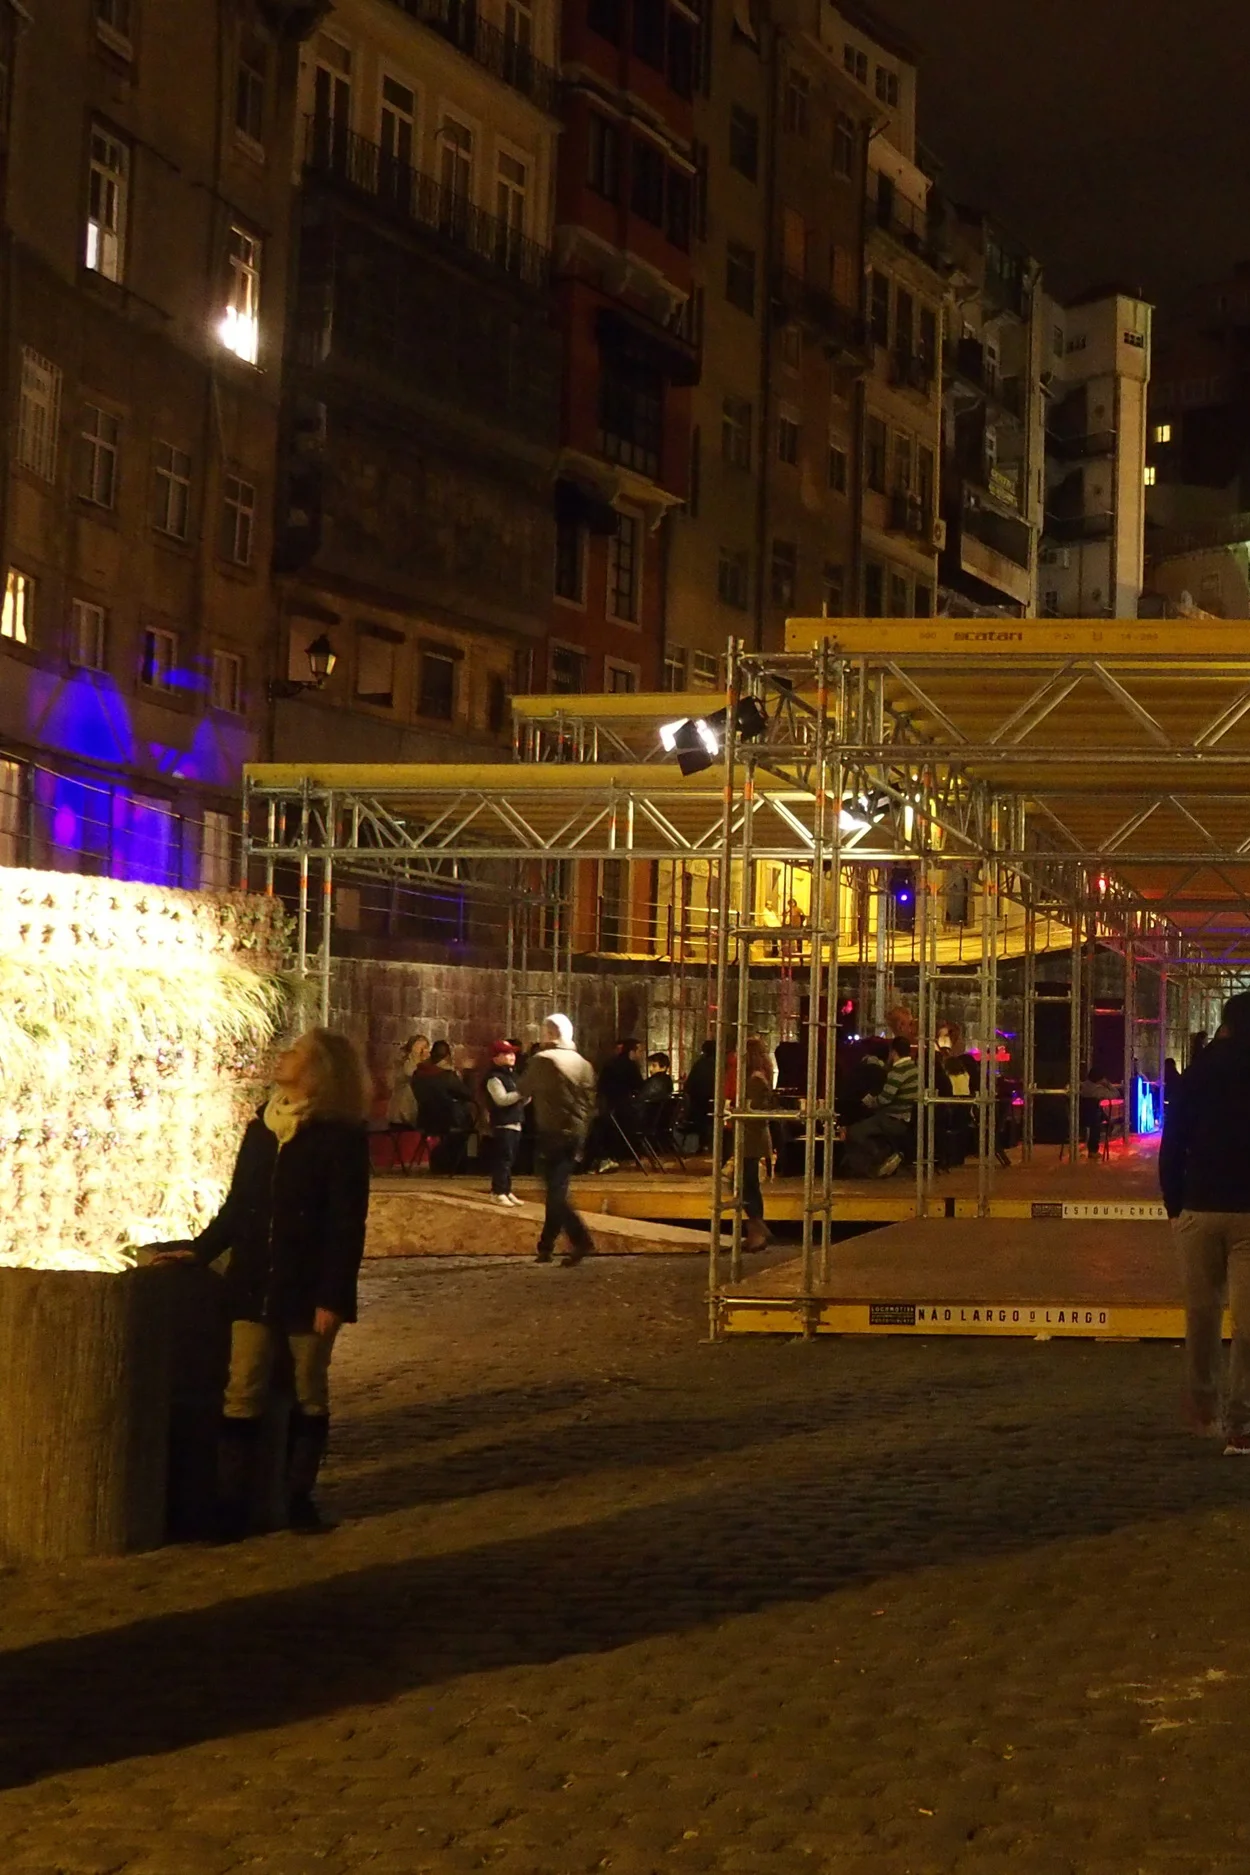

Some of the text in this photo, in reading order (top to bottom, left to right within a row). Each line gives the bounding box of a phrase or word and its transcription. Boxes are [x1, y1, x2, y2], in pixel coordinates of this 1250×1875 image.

[1129, 1206, 1164, 1216] CHEG
[918, 1307, 952, 1321] NÃO
[960, 1309, 1020, 1322] LARGO
[1045, 1310, 1107, 1324] LARGO
